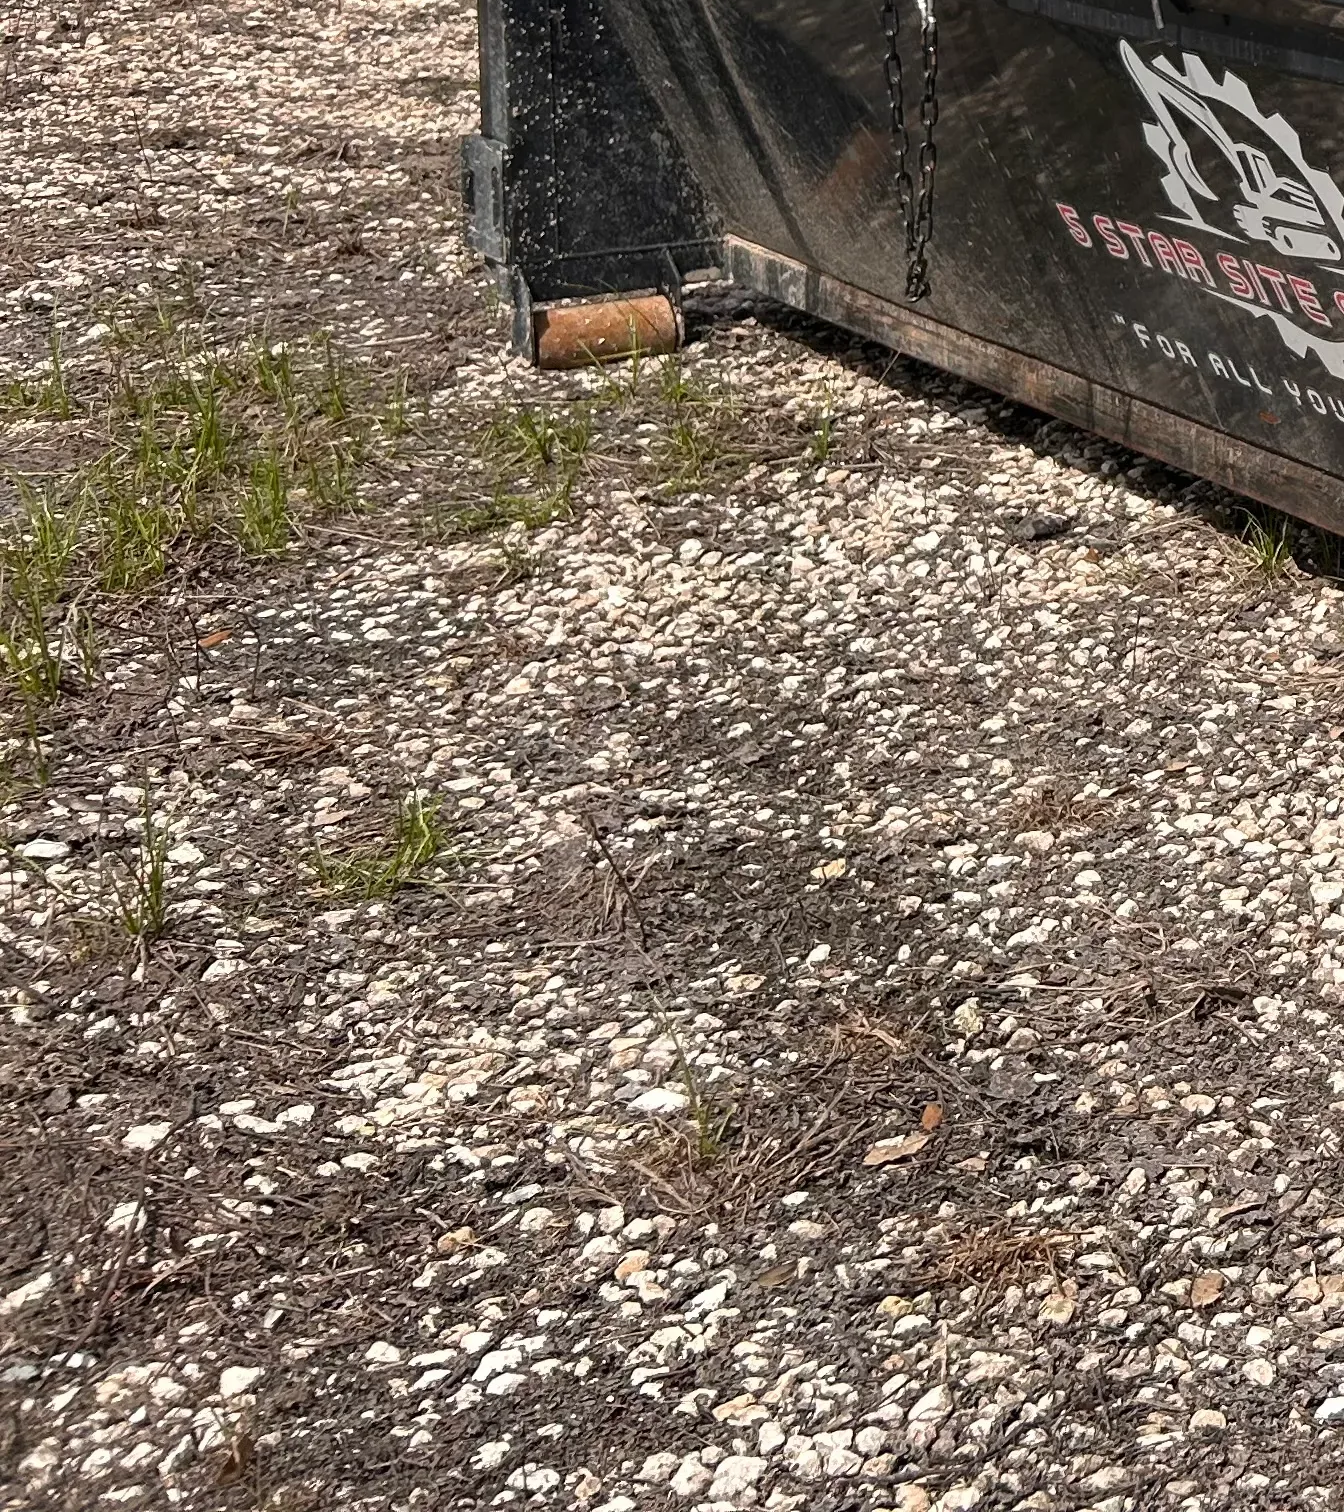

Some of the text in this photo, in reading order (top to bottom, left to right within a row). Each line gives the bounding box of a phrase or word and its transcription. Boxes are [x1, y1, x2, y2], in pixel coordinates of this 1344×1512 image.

[1056, 203, 1092, 249] 5
[1094, 215, 1214, 288] STAR
[1216, 253, 1333, 328] SITE
[1207, 351, 1273, 396] ALL
